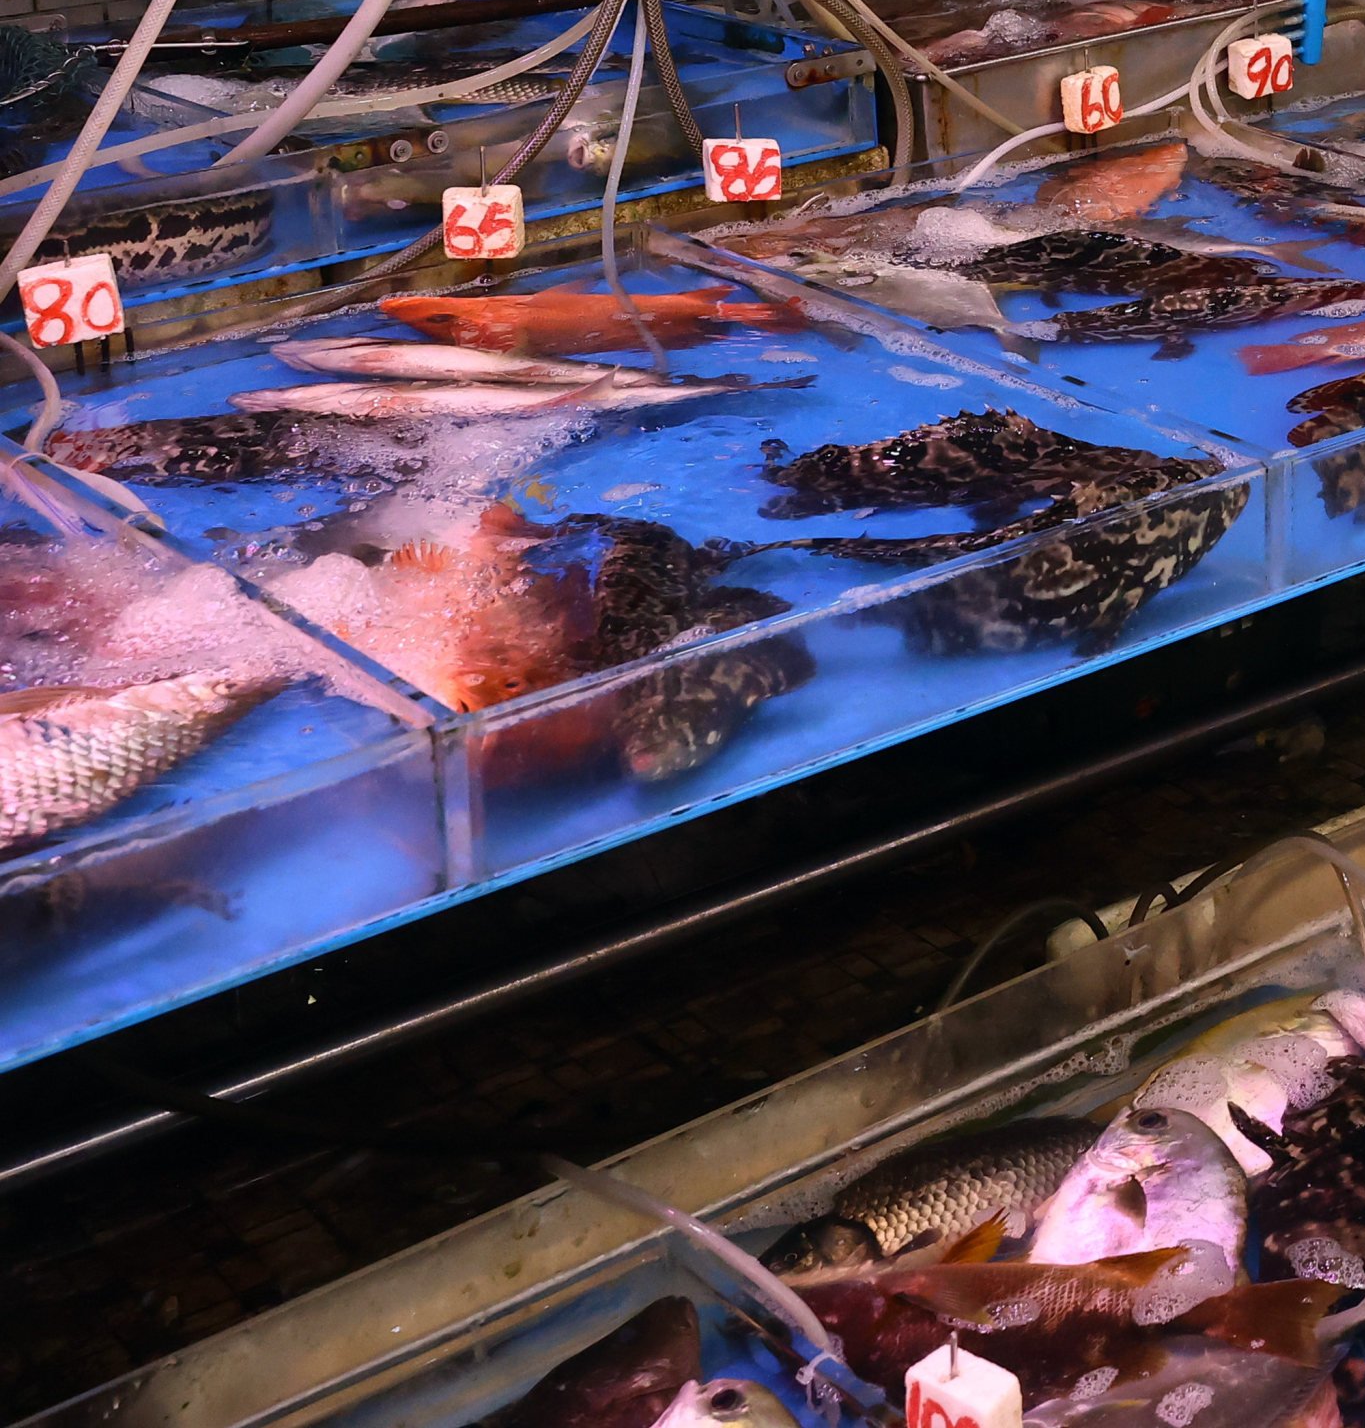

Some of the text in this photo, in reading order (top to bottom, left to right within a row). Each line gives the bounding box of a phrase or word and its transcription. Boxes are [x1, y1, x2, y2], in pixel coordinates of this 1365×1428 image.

[1080, 69, 1124, 132] 60
[1246, 46, 1293, 98] 90
[445, 202, 516, 257] 65
[20, 277, 122, 347] 80
